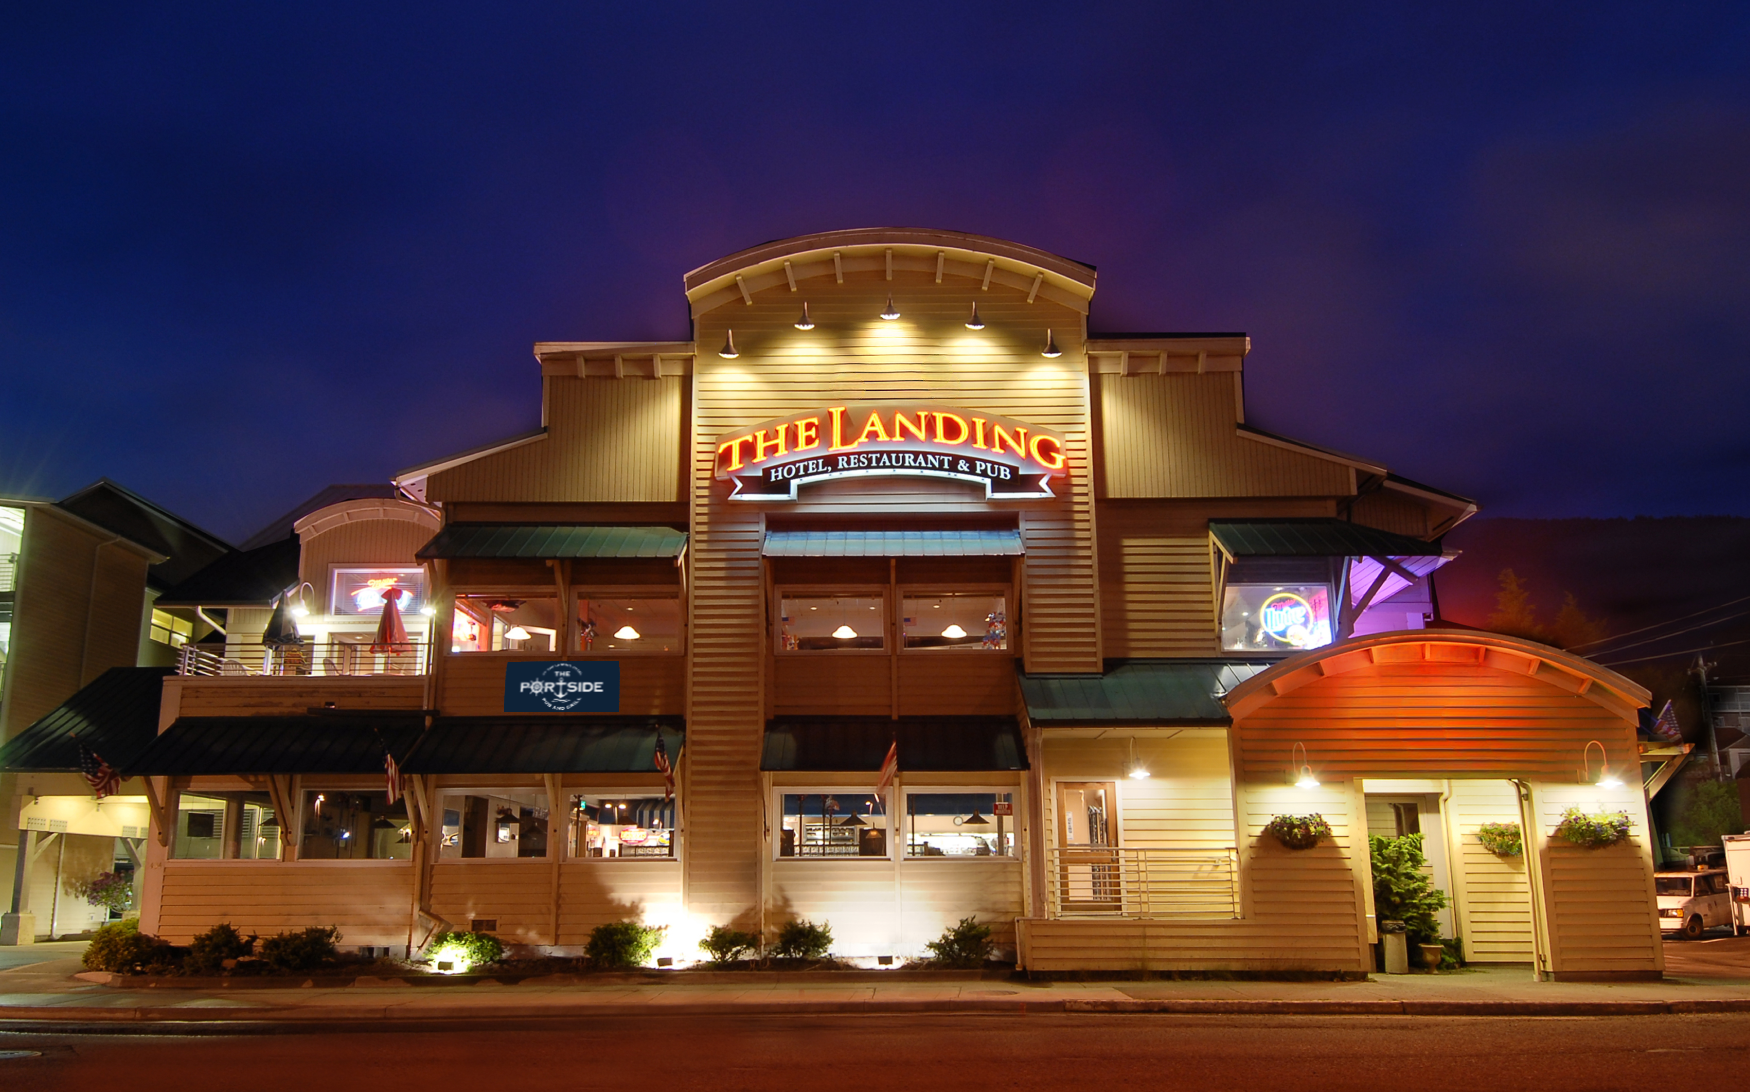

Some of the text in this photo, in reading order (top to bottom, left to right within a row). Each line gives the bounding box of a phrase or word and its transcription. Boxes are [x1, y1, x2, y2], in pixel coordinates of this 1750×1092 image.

[718, 406, 1067, 472] THE LANDING
[769, 452, 1011, 482] HOTEL, RESTAURANT & PUB
[520, 679, 604, 697] PORTSIDE
